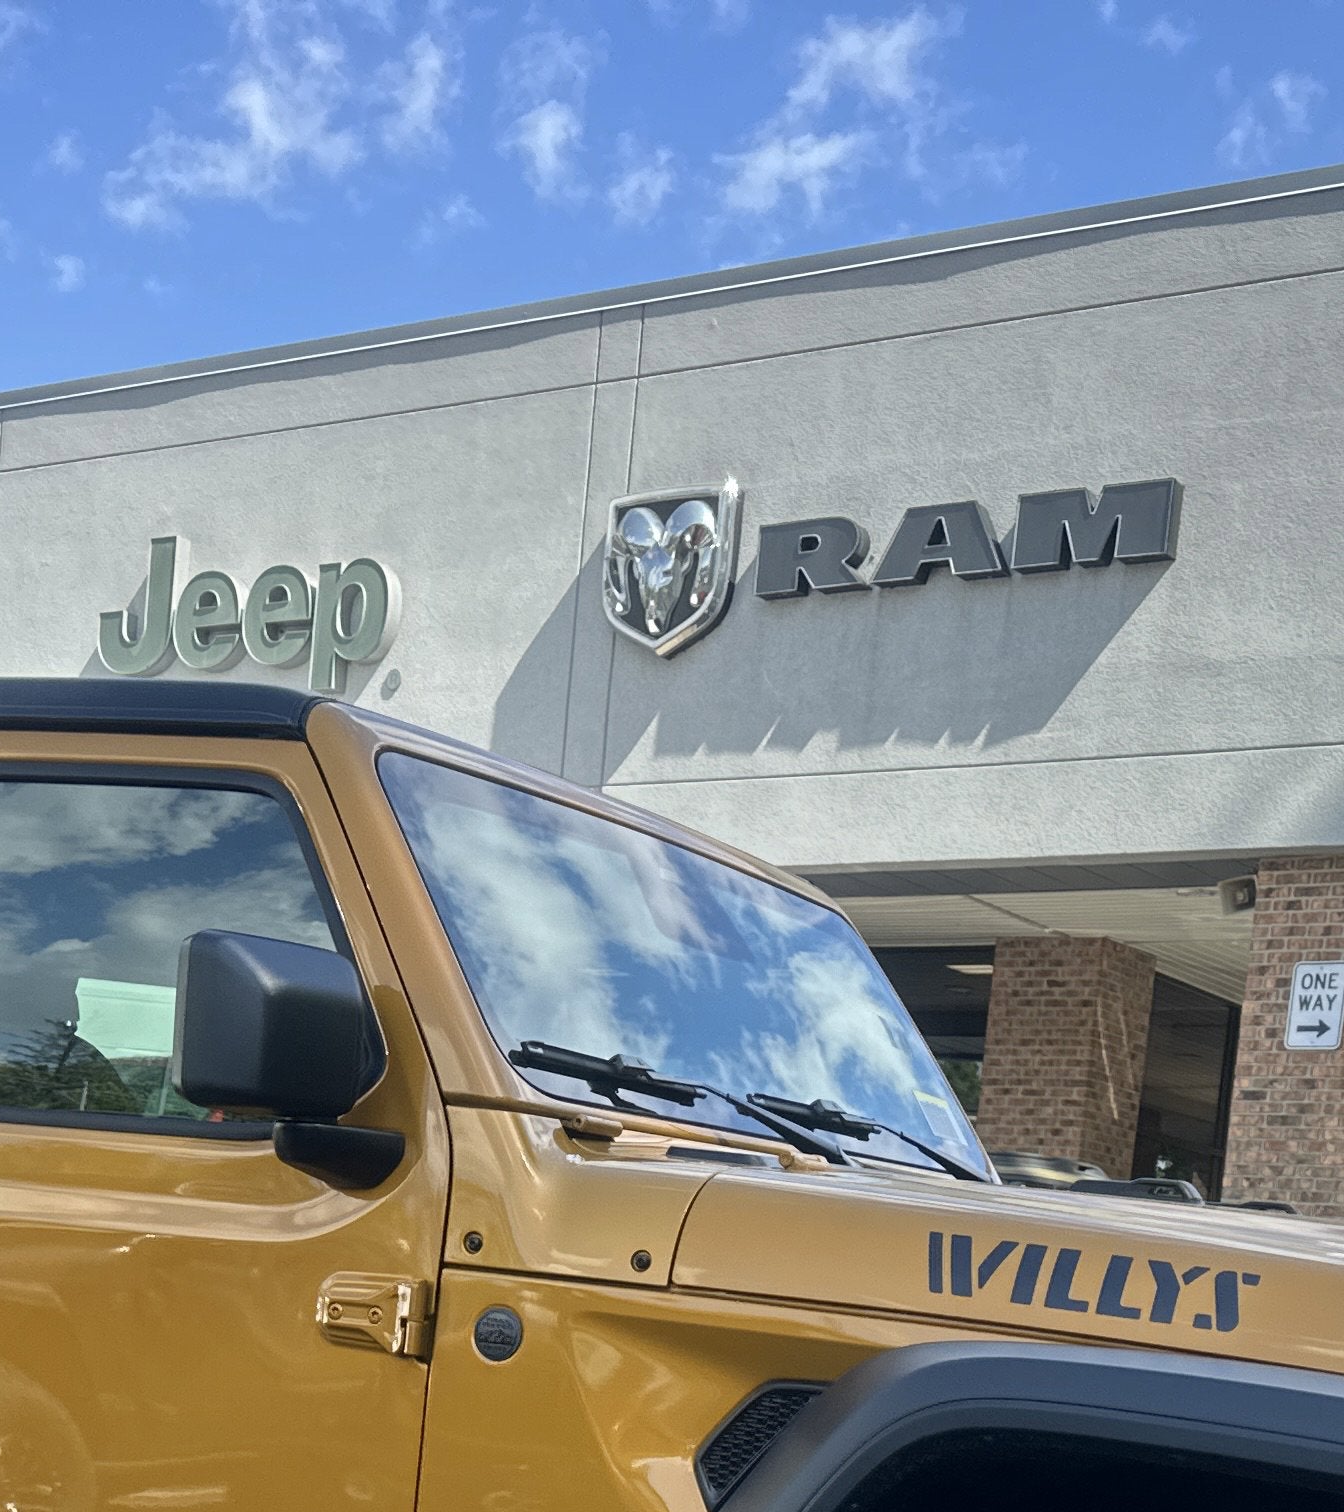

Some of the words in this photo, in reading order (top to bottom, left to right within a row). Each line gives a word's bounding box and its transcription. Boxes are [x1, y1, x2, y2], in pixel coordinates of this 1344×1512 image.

[754, 477, 1185, 599] RAM
[97, 535, 402, 694] Jeep
[1299, 994, 1338, 1011] WAY
[1301, 972, 1339, 990] ONE
[928, 1230, 1262, 1333] WILLYS
